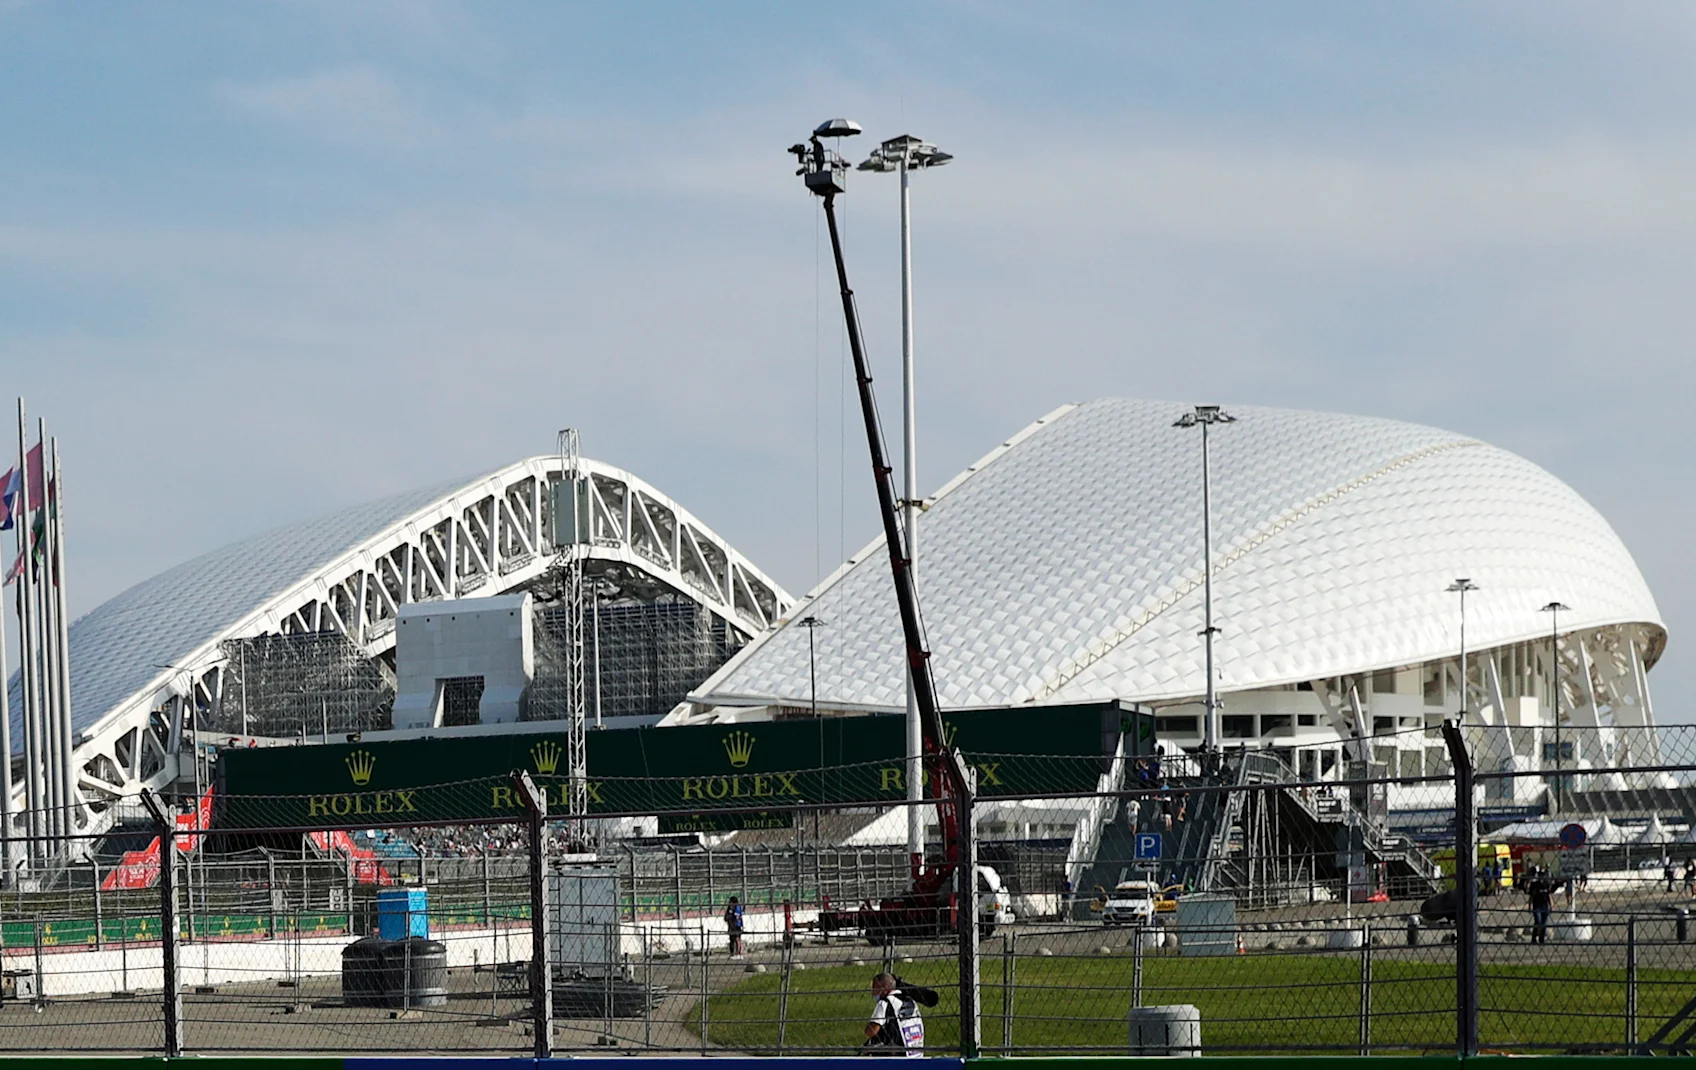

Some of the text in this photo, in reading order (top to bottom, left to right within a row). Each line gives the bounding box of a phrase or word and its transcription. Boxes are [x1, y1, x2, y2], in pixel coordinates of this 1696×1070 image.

[682, 773, 800, 800] ROLEX
[308, 791, 418, 816] ROLEX
[1141, 836, 1156, 856] P
